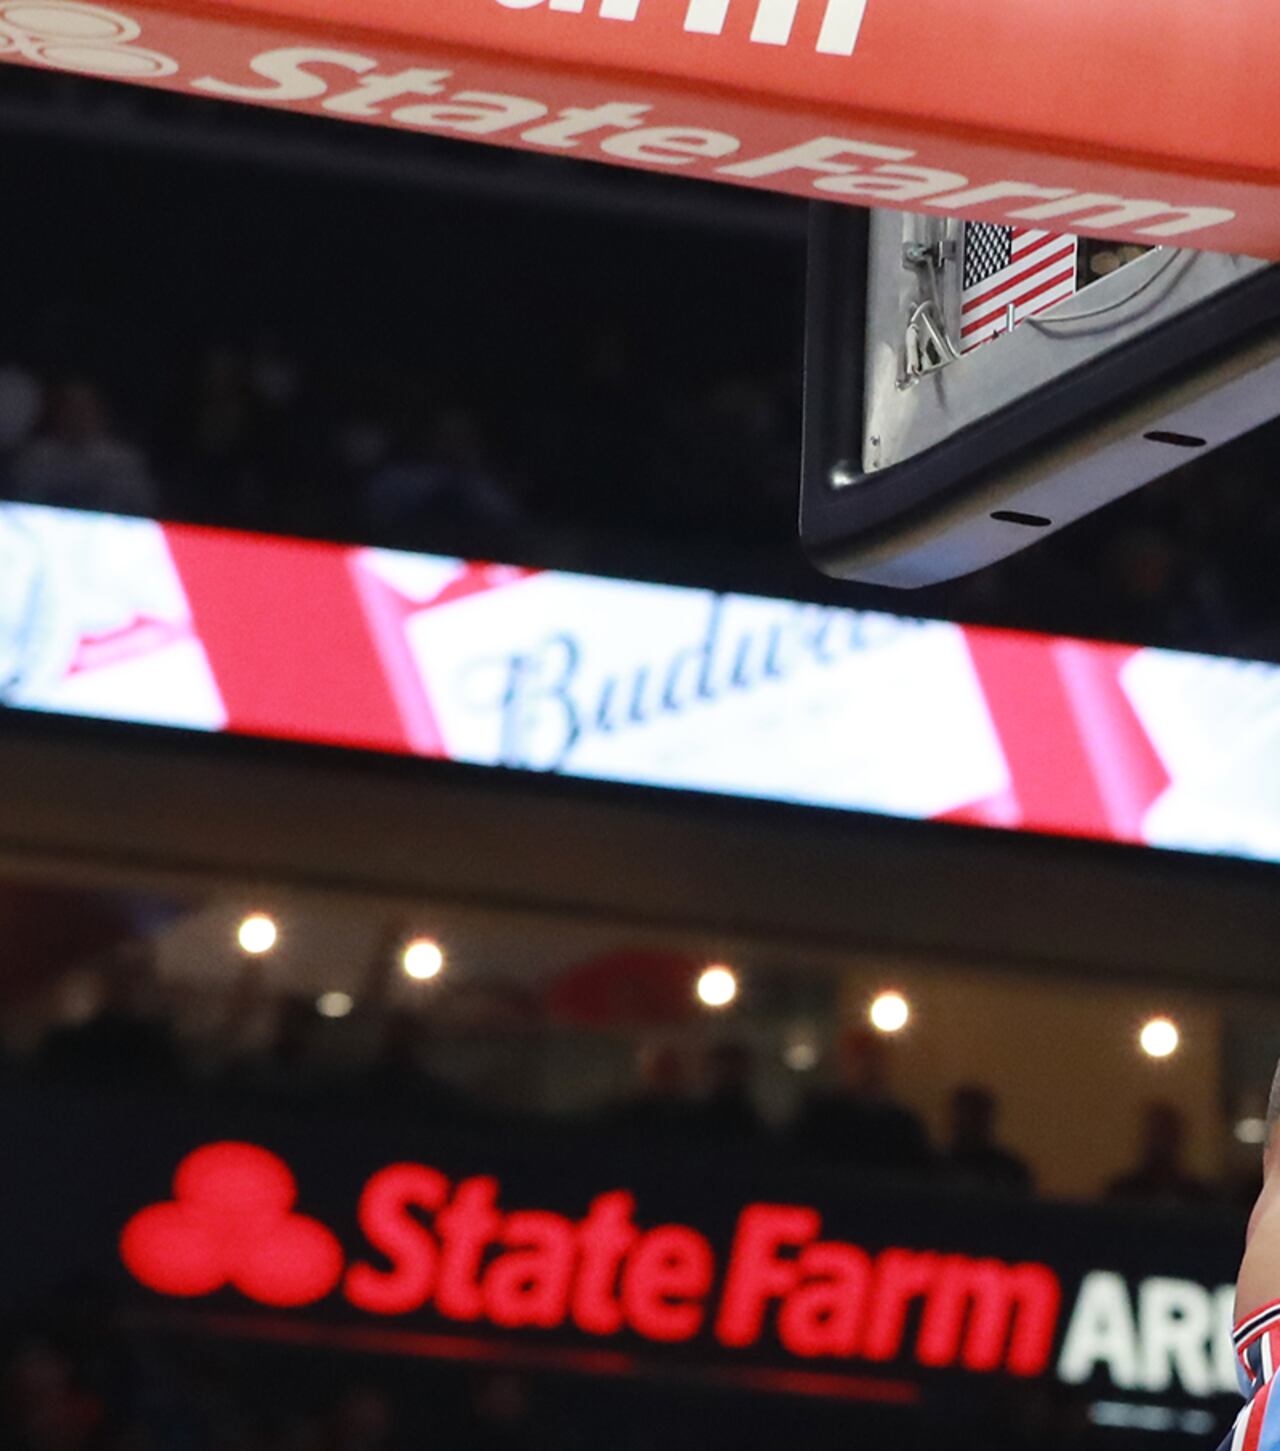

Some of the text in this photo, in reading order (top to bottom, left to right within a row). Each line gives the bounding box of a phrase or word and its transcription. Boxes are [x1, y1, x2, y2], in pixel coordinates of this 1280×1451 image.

[190, 46, 1236, 237] State Farm
[343, 1161, 717, 1345] State
[712, 1204, 1062, 1379] Farm
